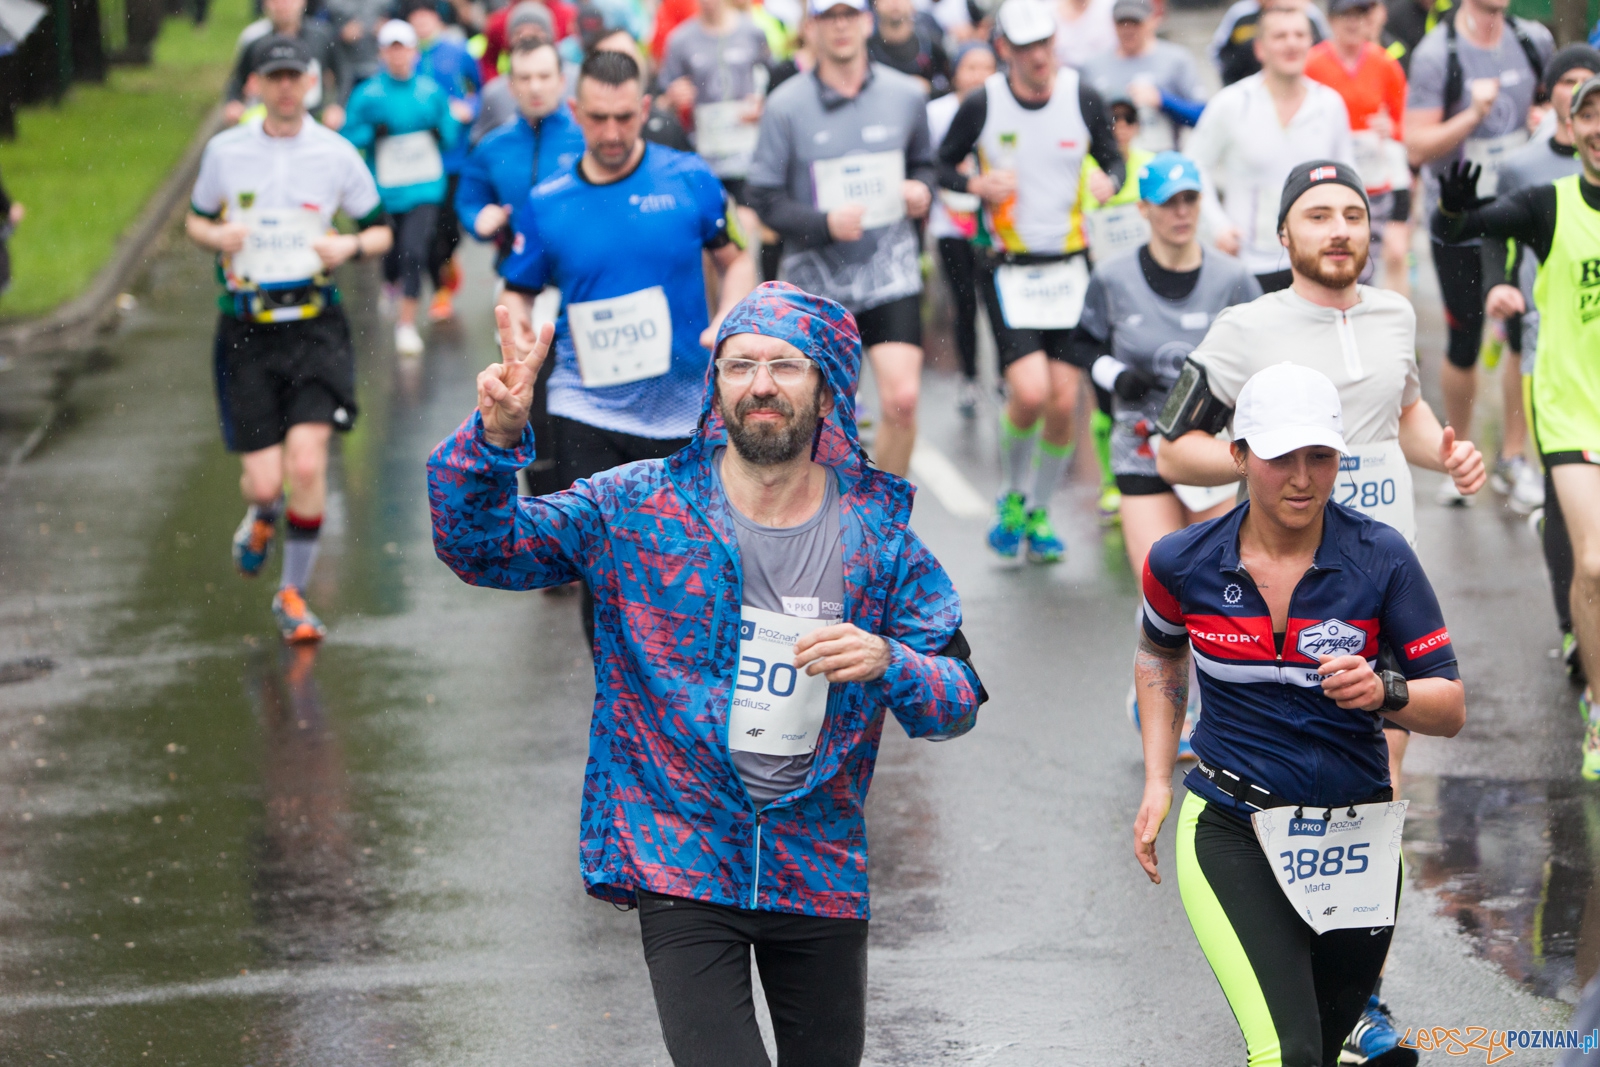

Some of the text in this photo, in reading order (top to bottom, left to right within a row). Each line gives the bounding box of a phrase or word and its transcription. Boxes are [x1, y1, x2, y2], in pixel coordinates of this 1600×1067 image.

[587, 319, 656, 350] 10790
[794, 603, 814, 612] PKO
[1191, 629, 1261, 643] FACTORY
[731, 695, 771, 711] adiusz
[745, 727, 765, 737] 4F
[1293, 822, 1301, 832] 9.
[1301, 822, 1322, 832] PKO
[1280, 843, 1370, 885] 3885
[1304, 882, 1331, 895] Marta
[1322, 906, 1338, 915] 4F
